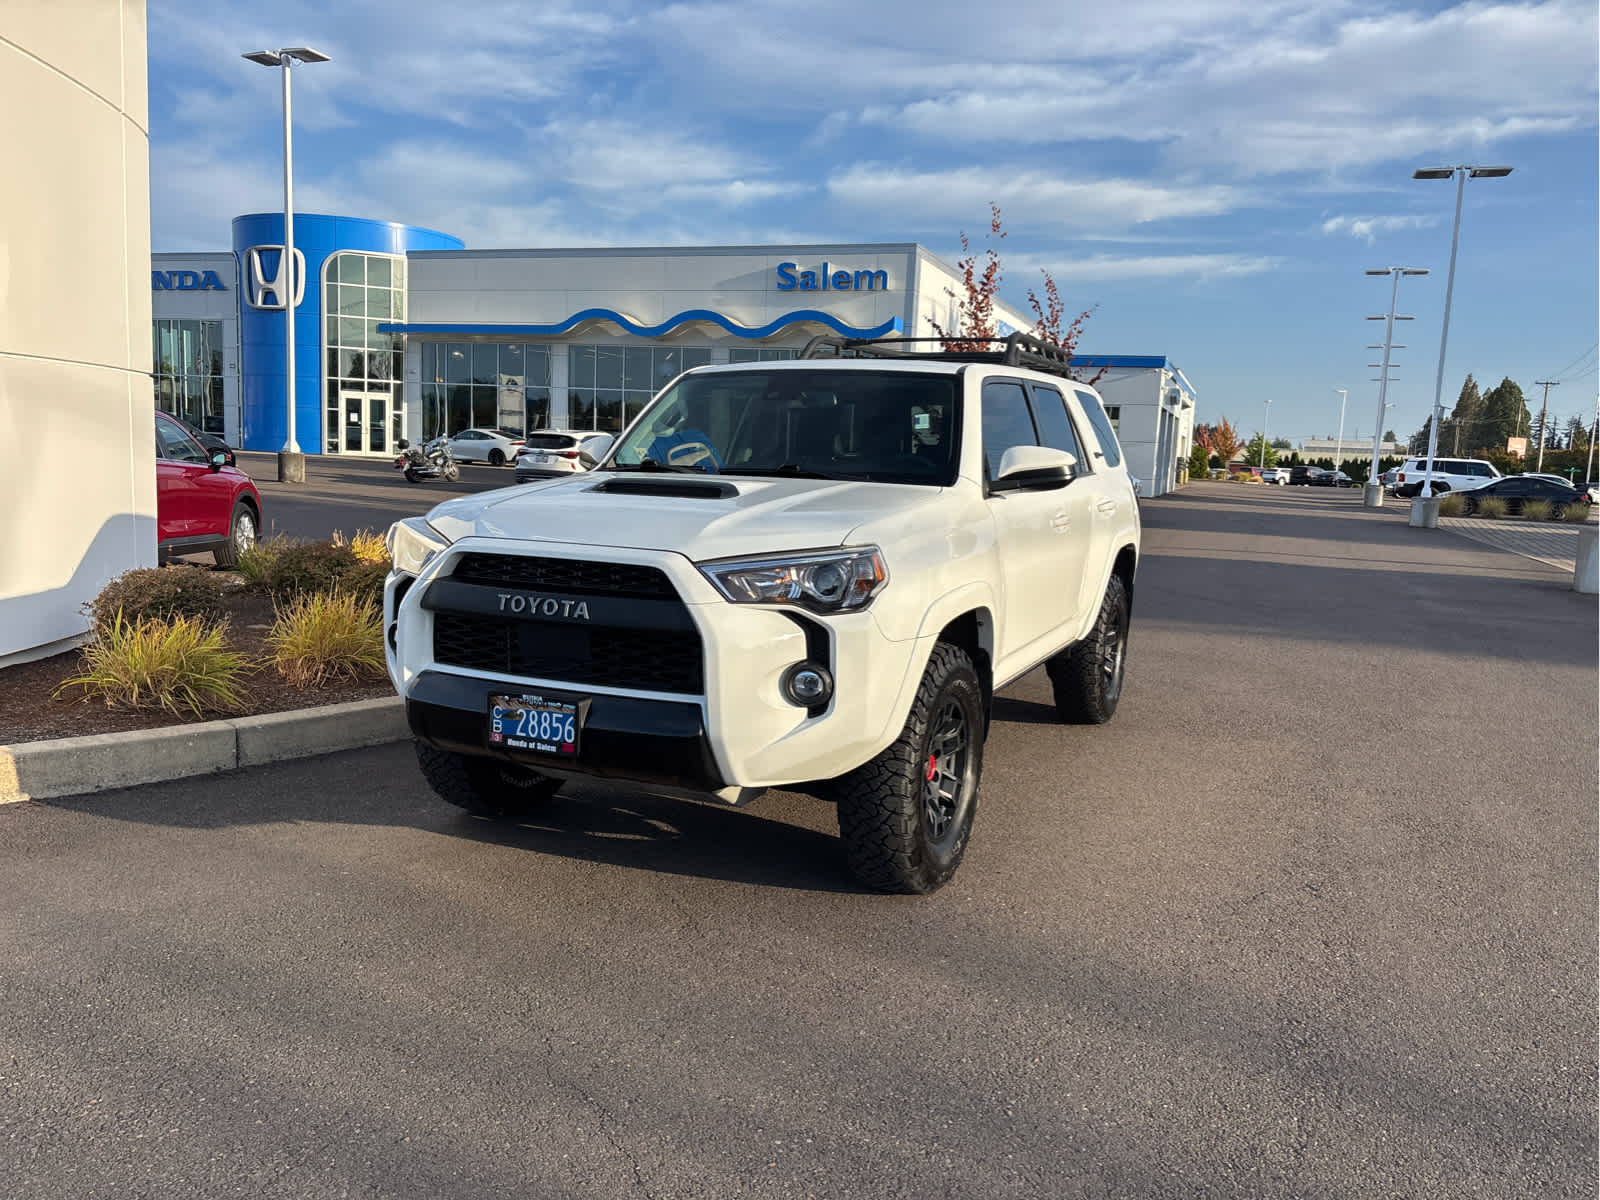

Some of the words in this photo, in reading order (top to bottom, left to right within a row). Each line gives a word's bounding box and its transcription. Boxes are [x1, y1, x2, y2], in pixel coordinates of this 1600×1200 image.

[776, 261, 890, 291] Salem
[497, 593, 590, 620] TOYOTA
[516, 708, 575, 743] 28856
[507, 738, 527, 749] Honda
[528, 741, 536, 749] of
[536, 743, 557, 753] Salem
